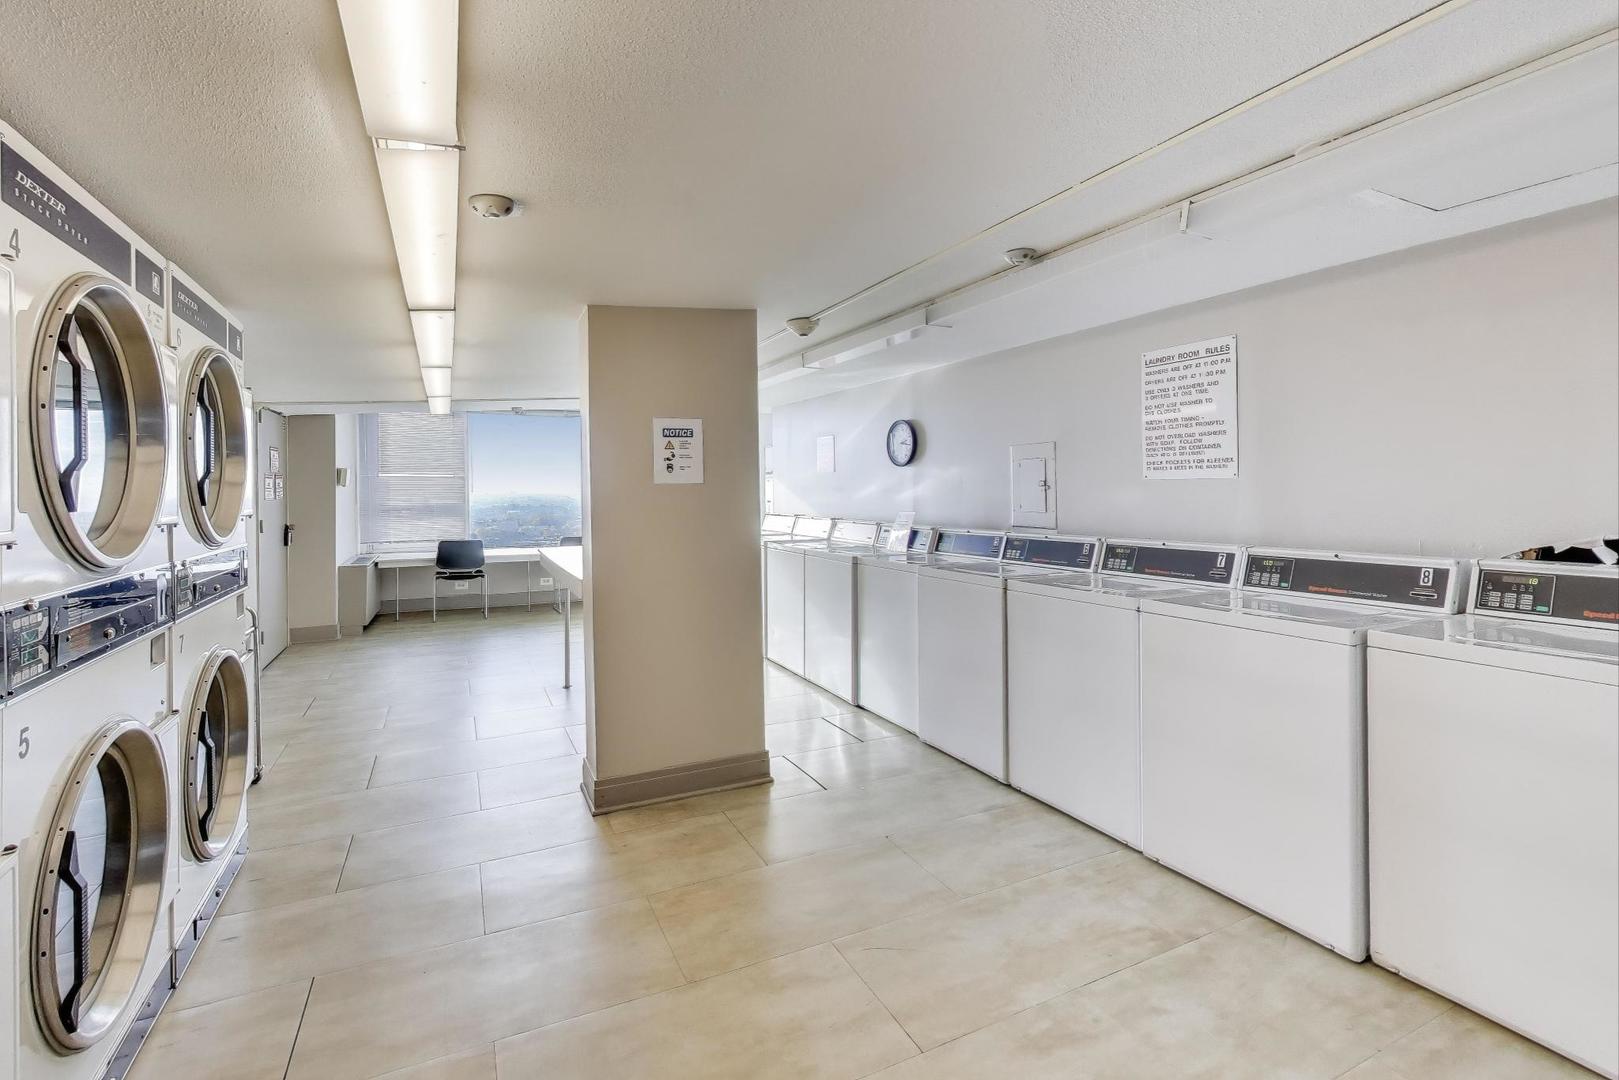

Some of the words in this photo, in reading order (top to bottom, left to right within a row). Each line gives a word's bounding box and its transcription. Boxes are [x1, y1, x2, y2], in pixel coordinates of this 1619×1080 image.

[14, 187, 51, 219] STACK
[15, 170, 68, 216] DEXTER
[9, 227, 22, 259] 4
[177, 291, 200, 311] DEXTER
[1145, 355, 1175, 365] LAUNDRY
[1178, 350, 1199, 360] ROOM
[1206, 344, 1230, 354] RULES
[663, 429, 693, 437] NOTICE
[179, 634, 184, 654] 7
[19, 726, 30, 759] 5
